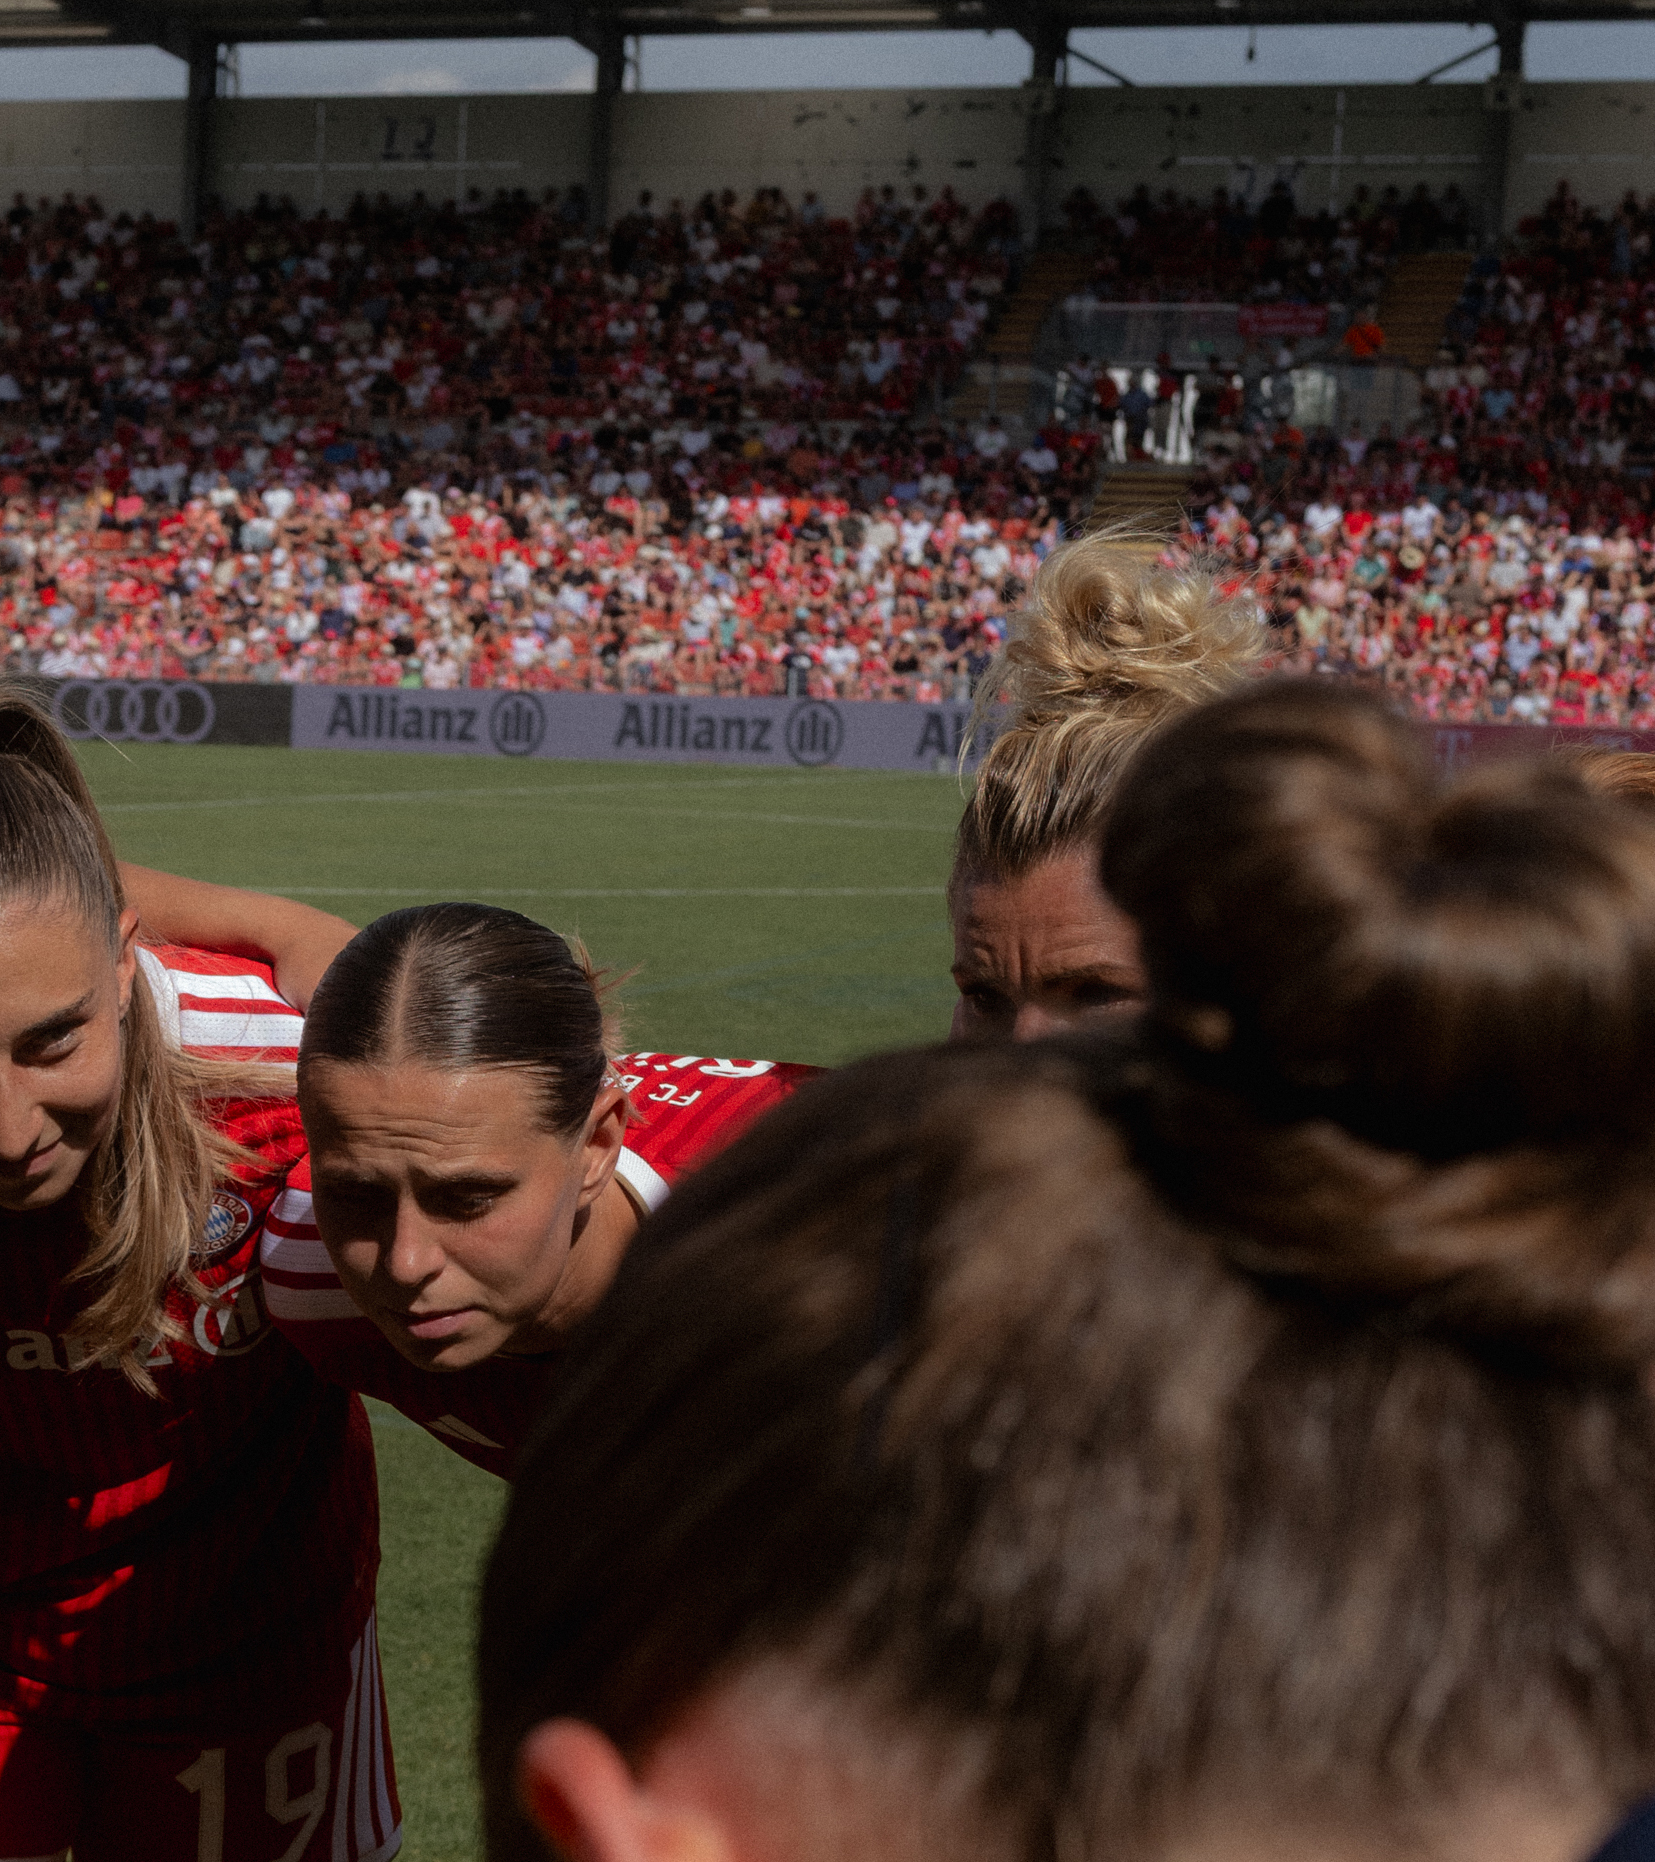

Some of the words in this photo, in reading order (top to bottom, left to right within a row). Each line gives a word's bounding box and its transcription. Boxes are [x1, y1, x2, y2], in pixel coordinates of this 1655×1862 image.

[324, 692, 478, 741] Allianz
[613, 702, 773, 752] Allianz
[648, 1083, 702, 1107] FC
[175, 1721, 333, 1862] 19
